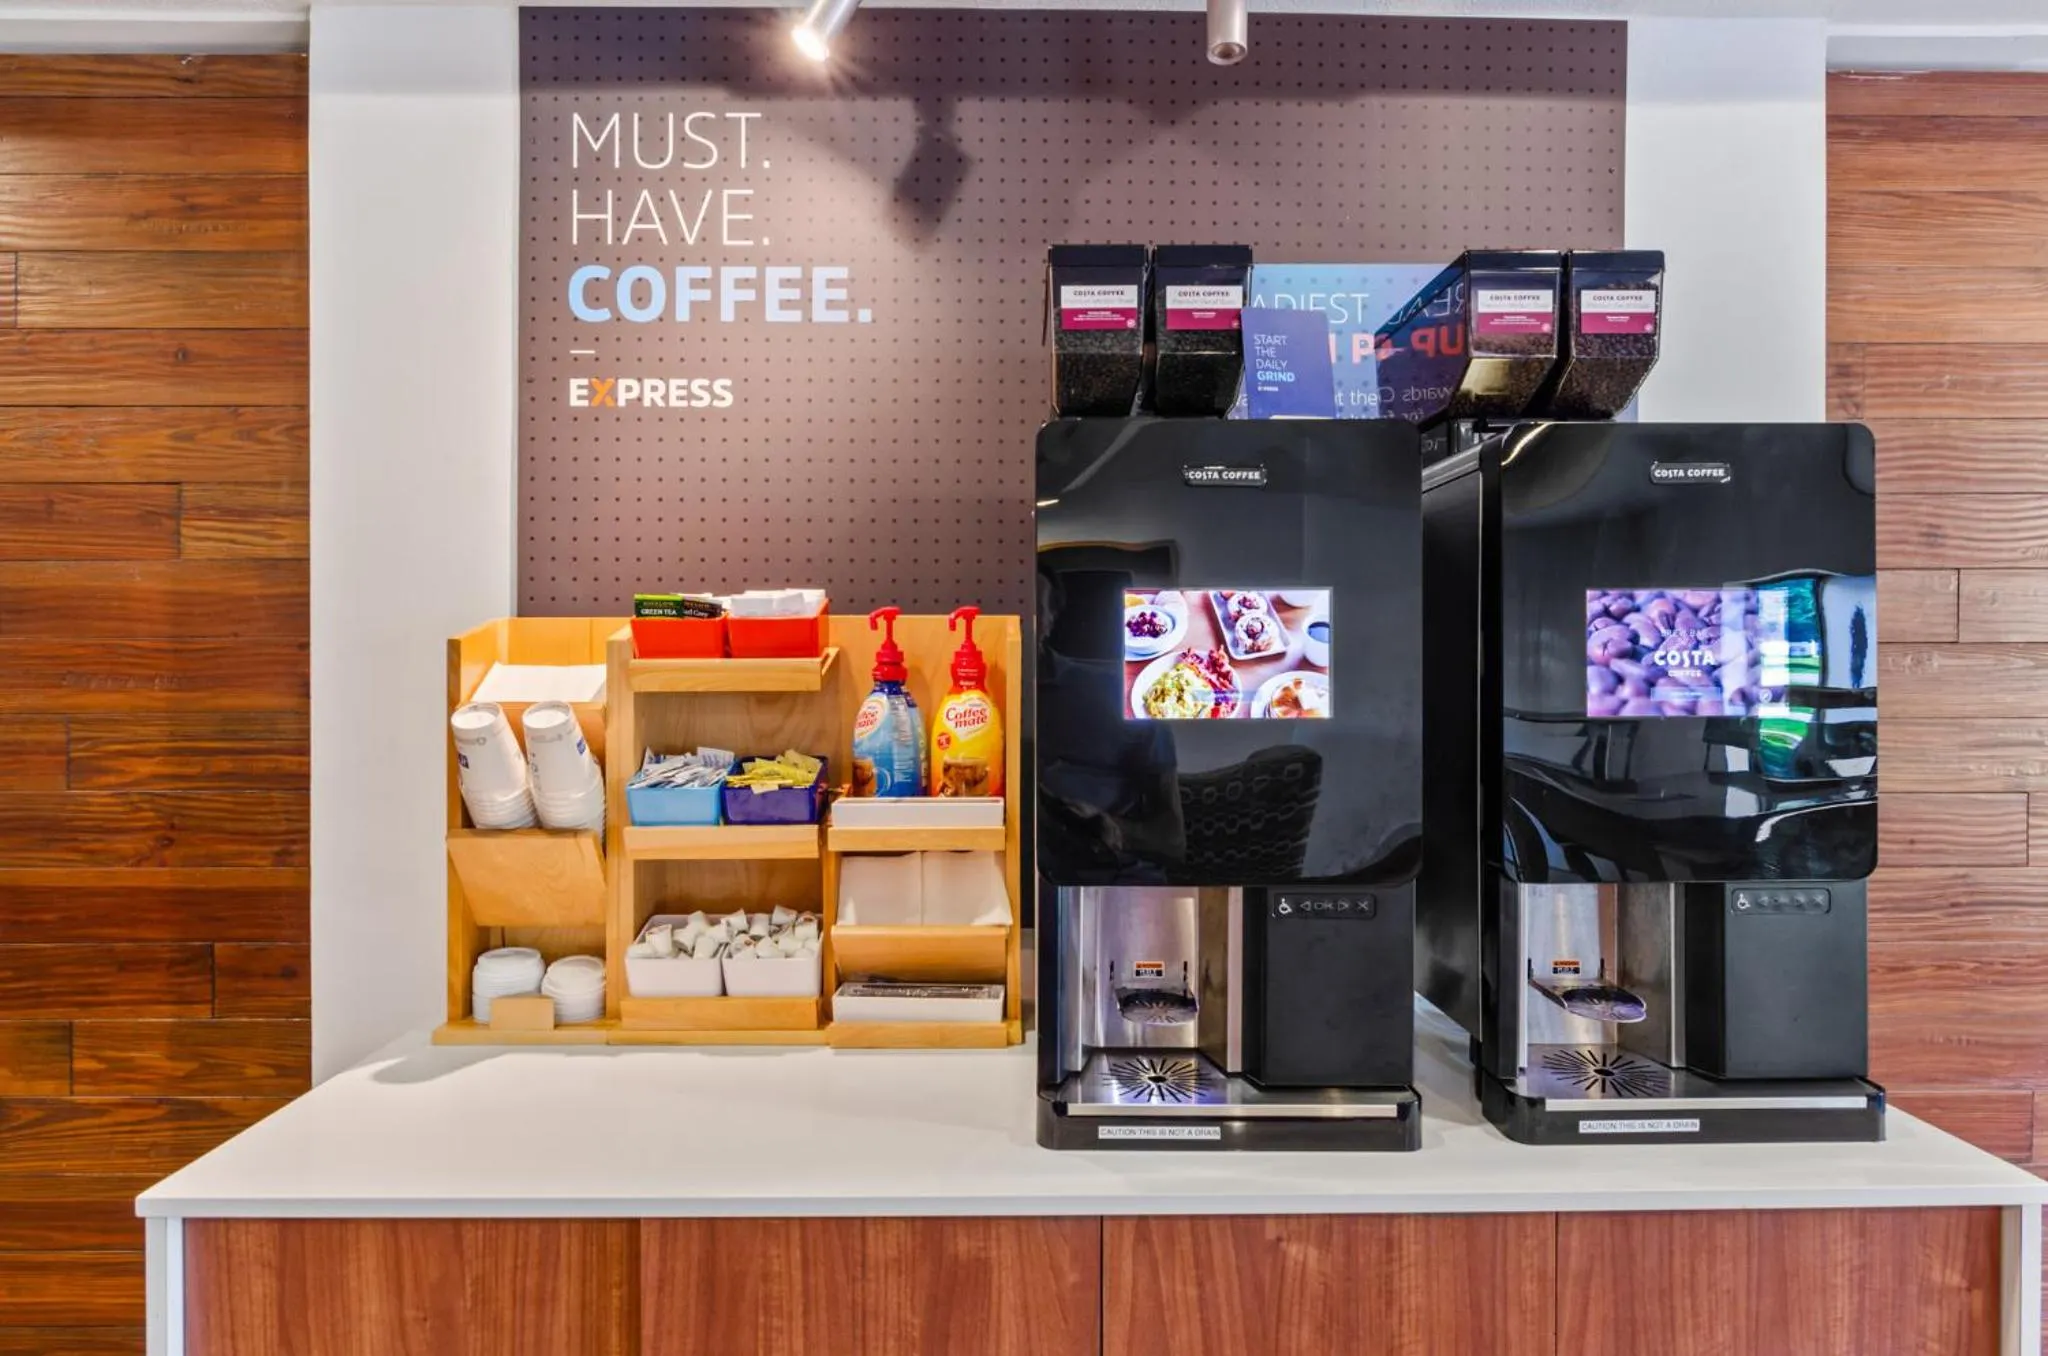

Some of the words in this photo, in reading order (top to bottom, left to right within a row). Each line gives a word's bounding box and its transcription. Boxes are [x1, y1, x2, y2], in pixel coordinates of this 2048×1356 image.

[572, 112, 771, 169] MUST.
[572, 188, 771, 246] HAVE.
[568, 264, 873, 323] COFFEE.
[1254, 334, 1287, 346] START
[1254, 346, 1277, 358] THE
[1256, 359, 1288, 371] DAILY
[1257, 371, 1296, 382] GRIND
[569, 378, 734, 407] EXPRESS
[1188, 471, 1220, 480] COSTA
[1222, 471, 1261, 480] COFFEE
[1654, 469, 1685, 478] COSTA
[1687, 468, 1725, 477] COFFEE
[664, 608, 677, 616] TEA
[1654, 650, 1715, 668] COSTA
[945, 707, 987, 722] Coffee
[954, 714, 988, 729] mate
[1100, 1128, 1136, 1136] CAUTION
